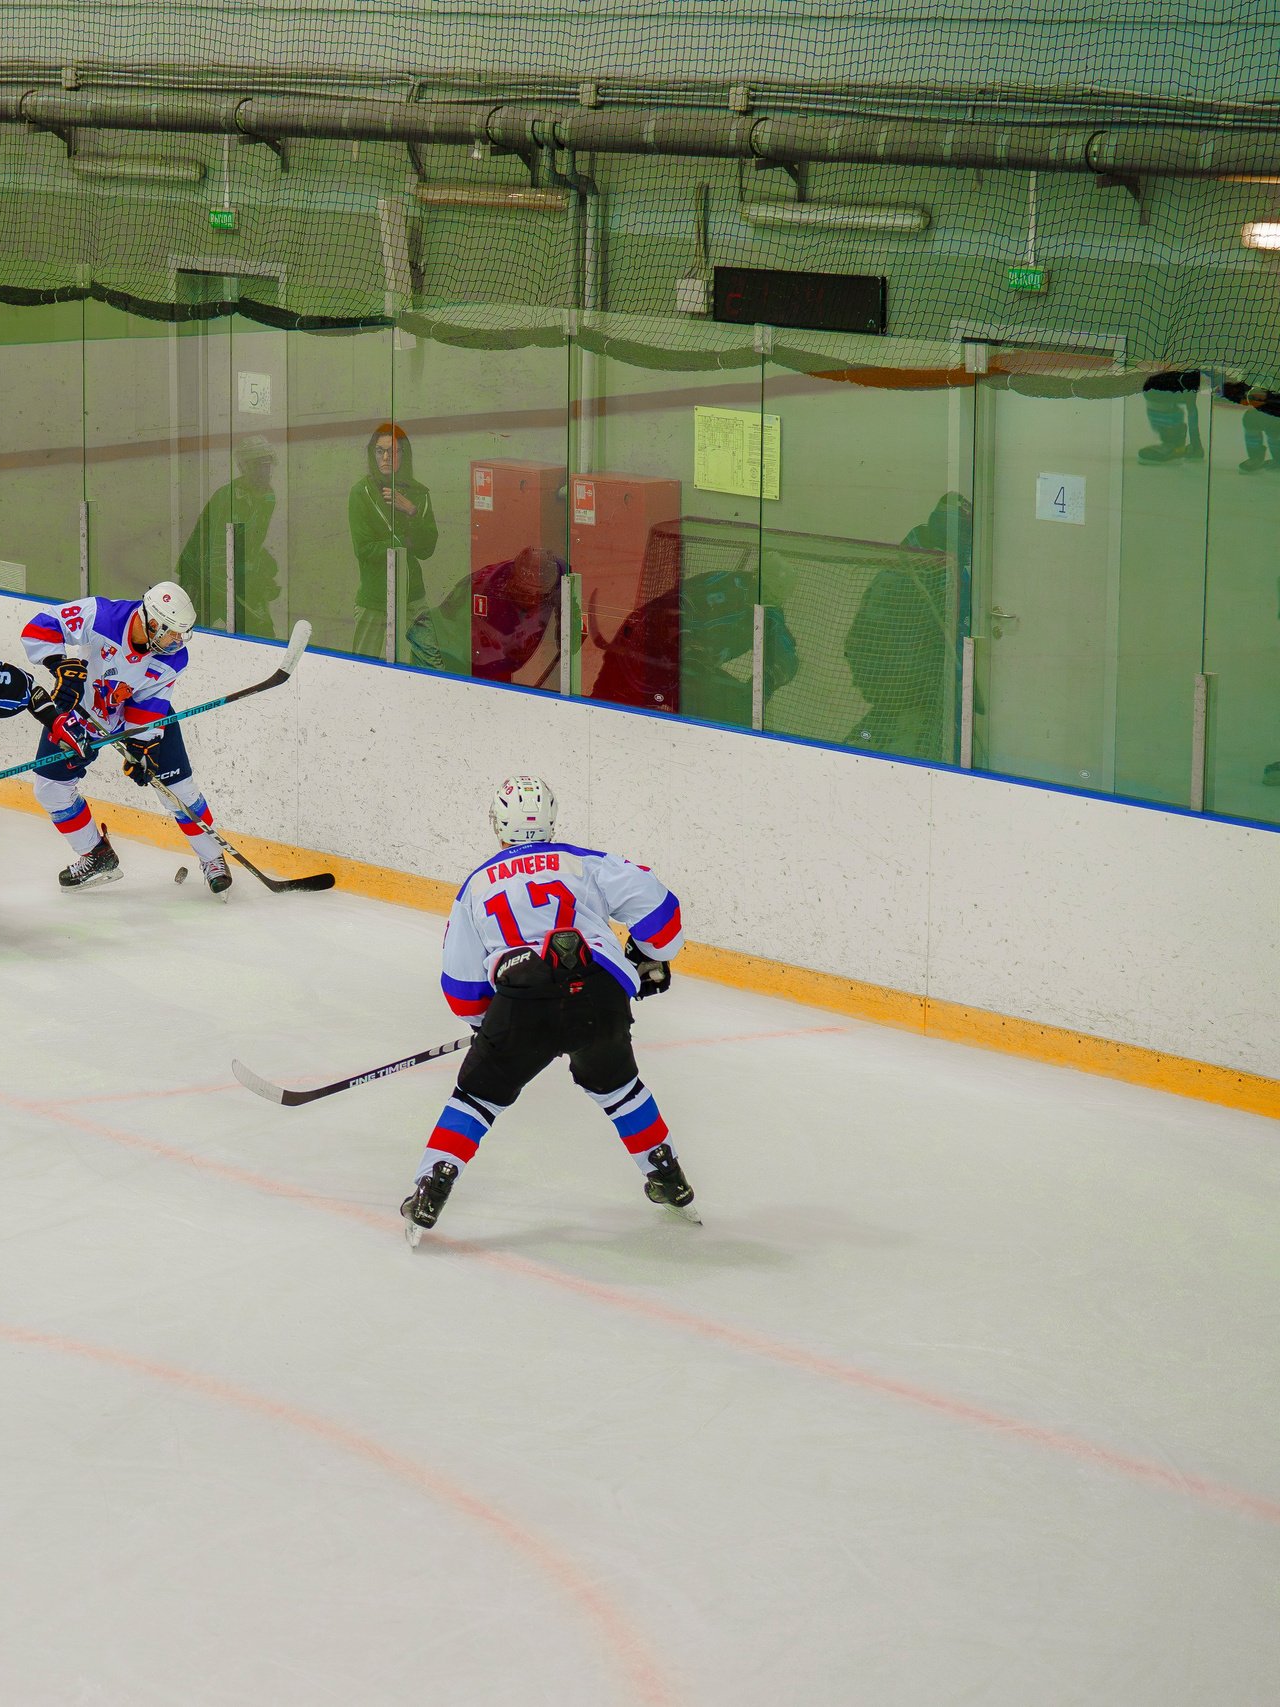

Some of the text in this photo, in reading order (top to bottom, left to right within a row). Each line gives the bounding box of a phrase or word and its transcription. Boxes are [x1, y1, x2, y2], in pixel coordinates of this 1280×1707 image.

[249, 382, 259, 406] 5
[1053, 486, 1067, 513] 4
[61, 605, 83, 633] 86
[525, 830, 536, 840] 17
[486, 853, 560, 885] ГАЛЕЕВ
[483, 879, 577, 948] 17
[349, 1058, 417, 1088] ONE TIMER
